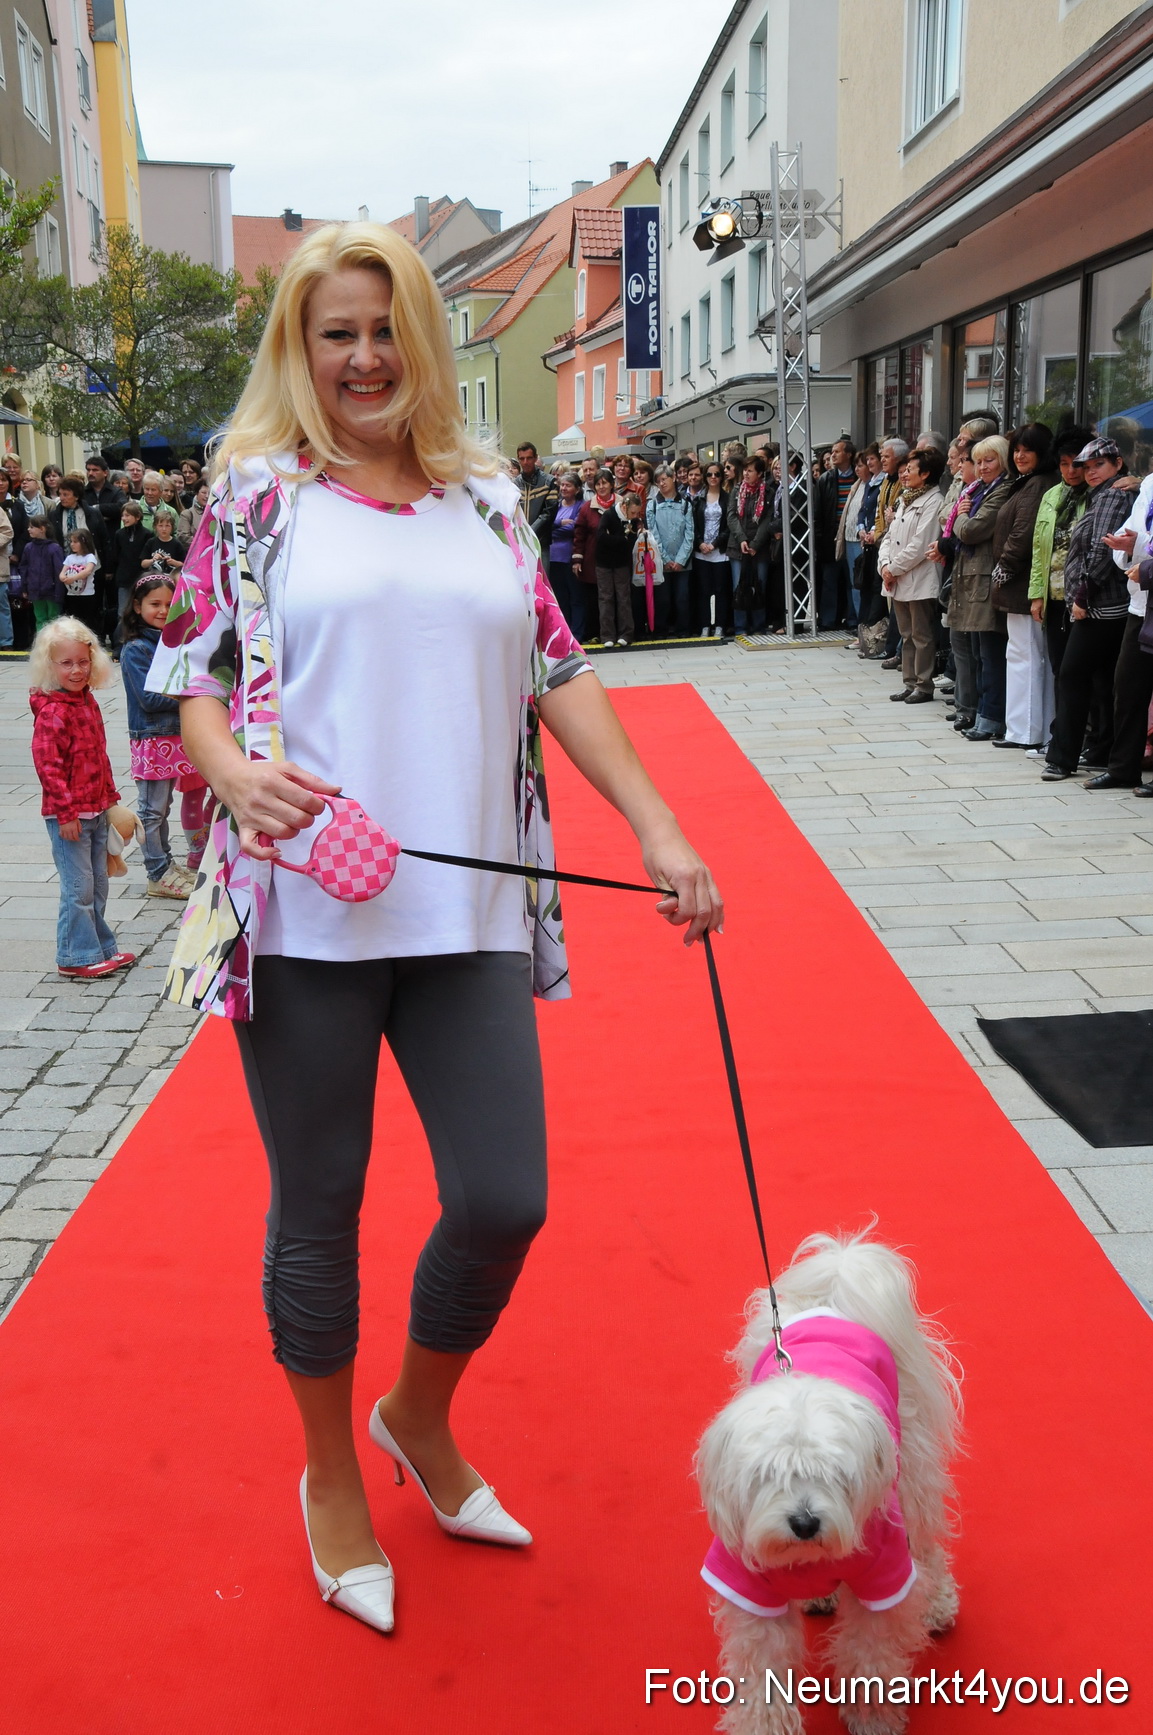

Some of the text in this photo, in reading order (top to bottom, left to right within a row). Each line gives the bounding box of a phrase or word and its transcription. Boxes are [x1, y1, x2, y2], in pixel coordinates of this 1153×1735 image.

[631, 279, 642, 298] T
[647, 220, 658, 356] TOM TAILOR
[649, 435, 668, 447] T
